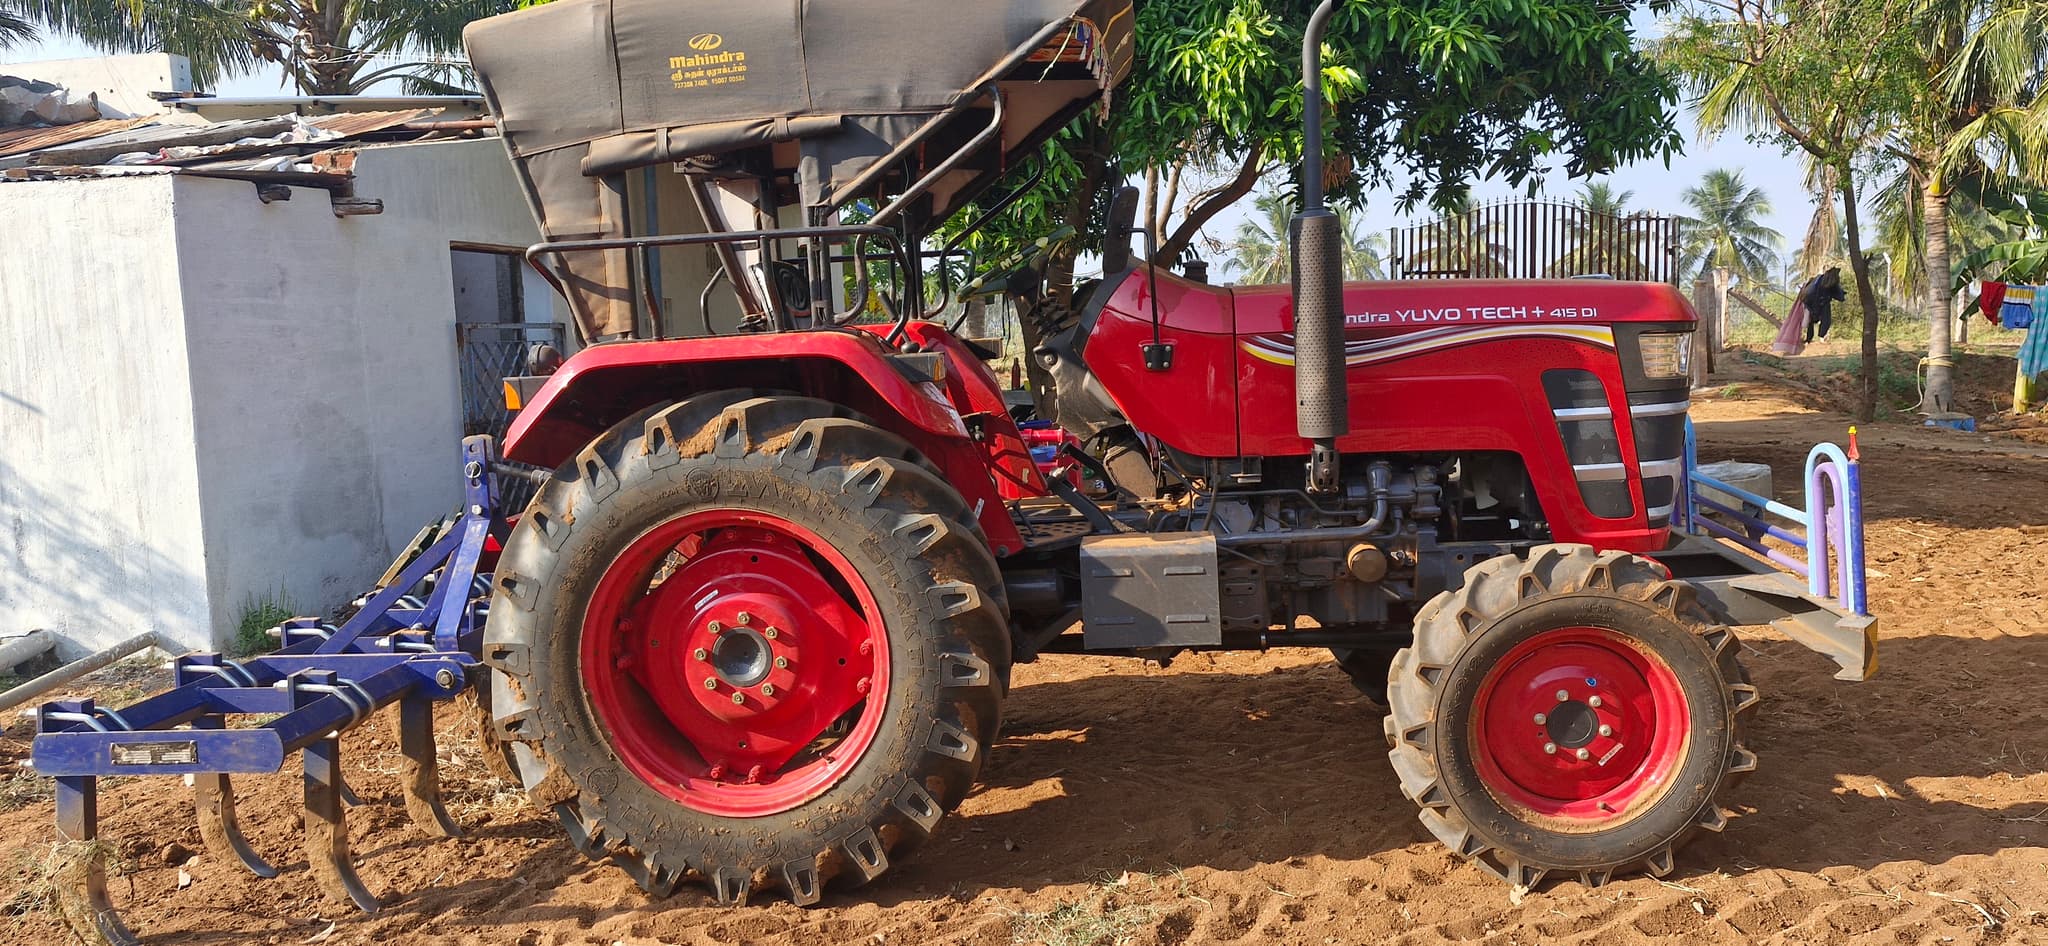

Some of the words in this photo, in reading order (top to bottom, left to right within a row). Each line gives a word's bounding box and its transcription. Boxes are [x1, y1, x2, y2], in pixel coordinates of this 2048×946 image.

[669, 51, 745, 69] Mahindra
[1345, 312, 1390, 324] ndra
[1395, 308, 1461, 322] YUVO
[1466, 306, 1527, 320] TECH
[1550, 308, 1577, 318] 415
[1581, 307, 1597, 317] DI
